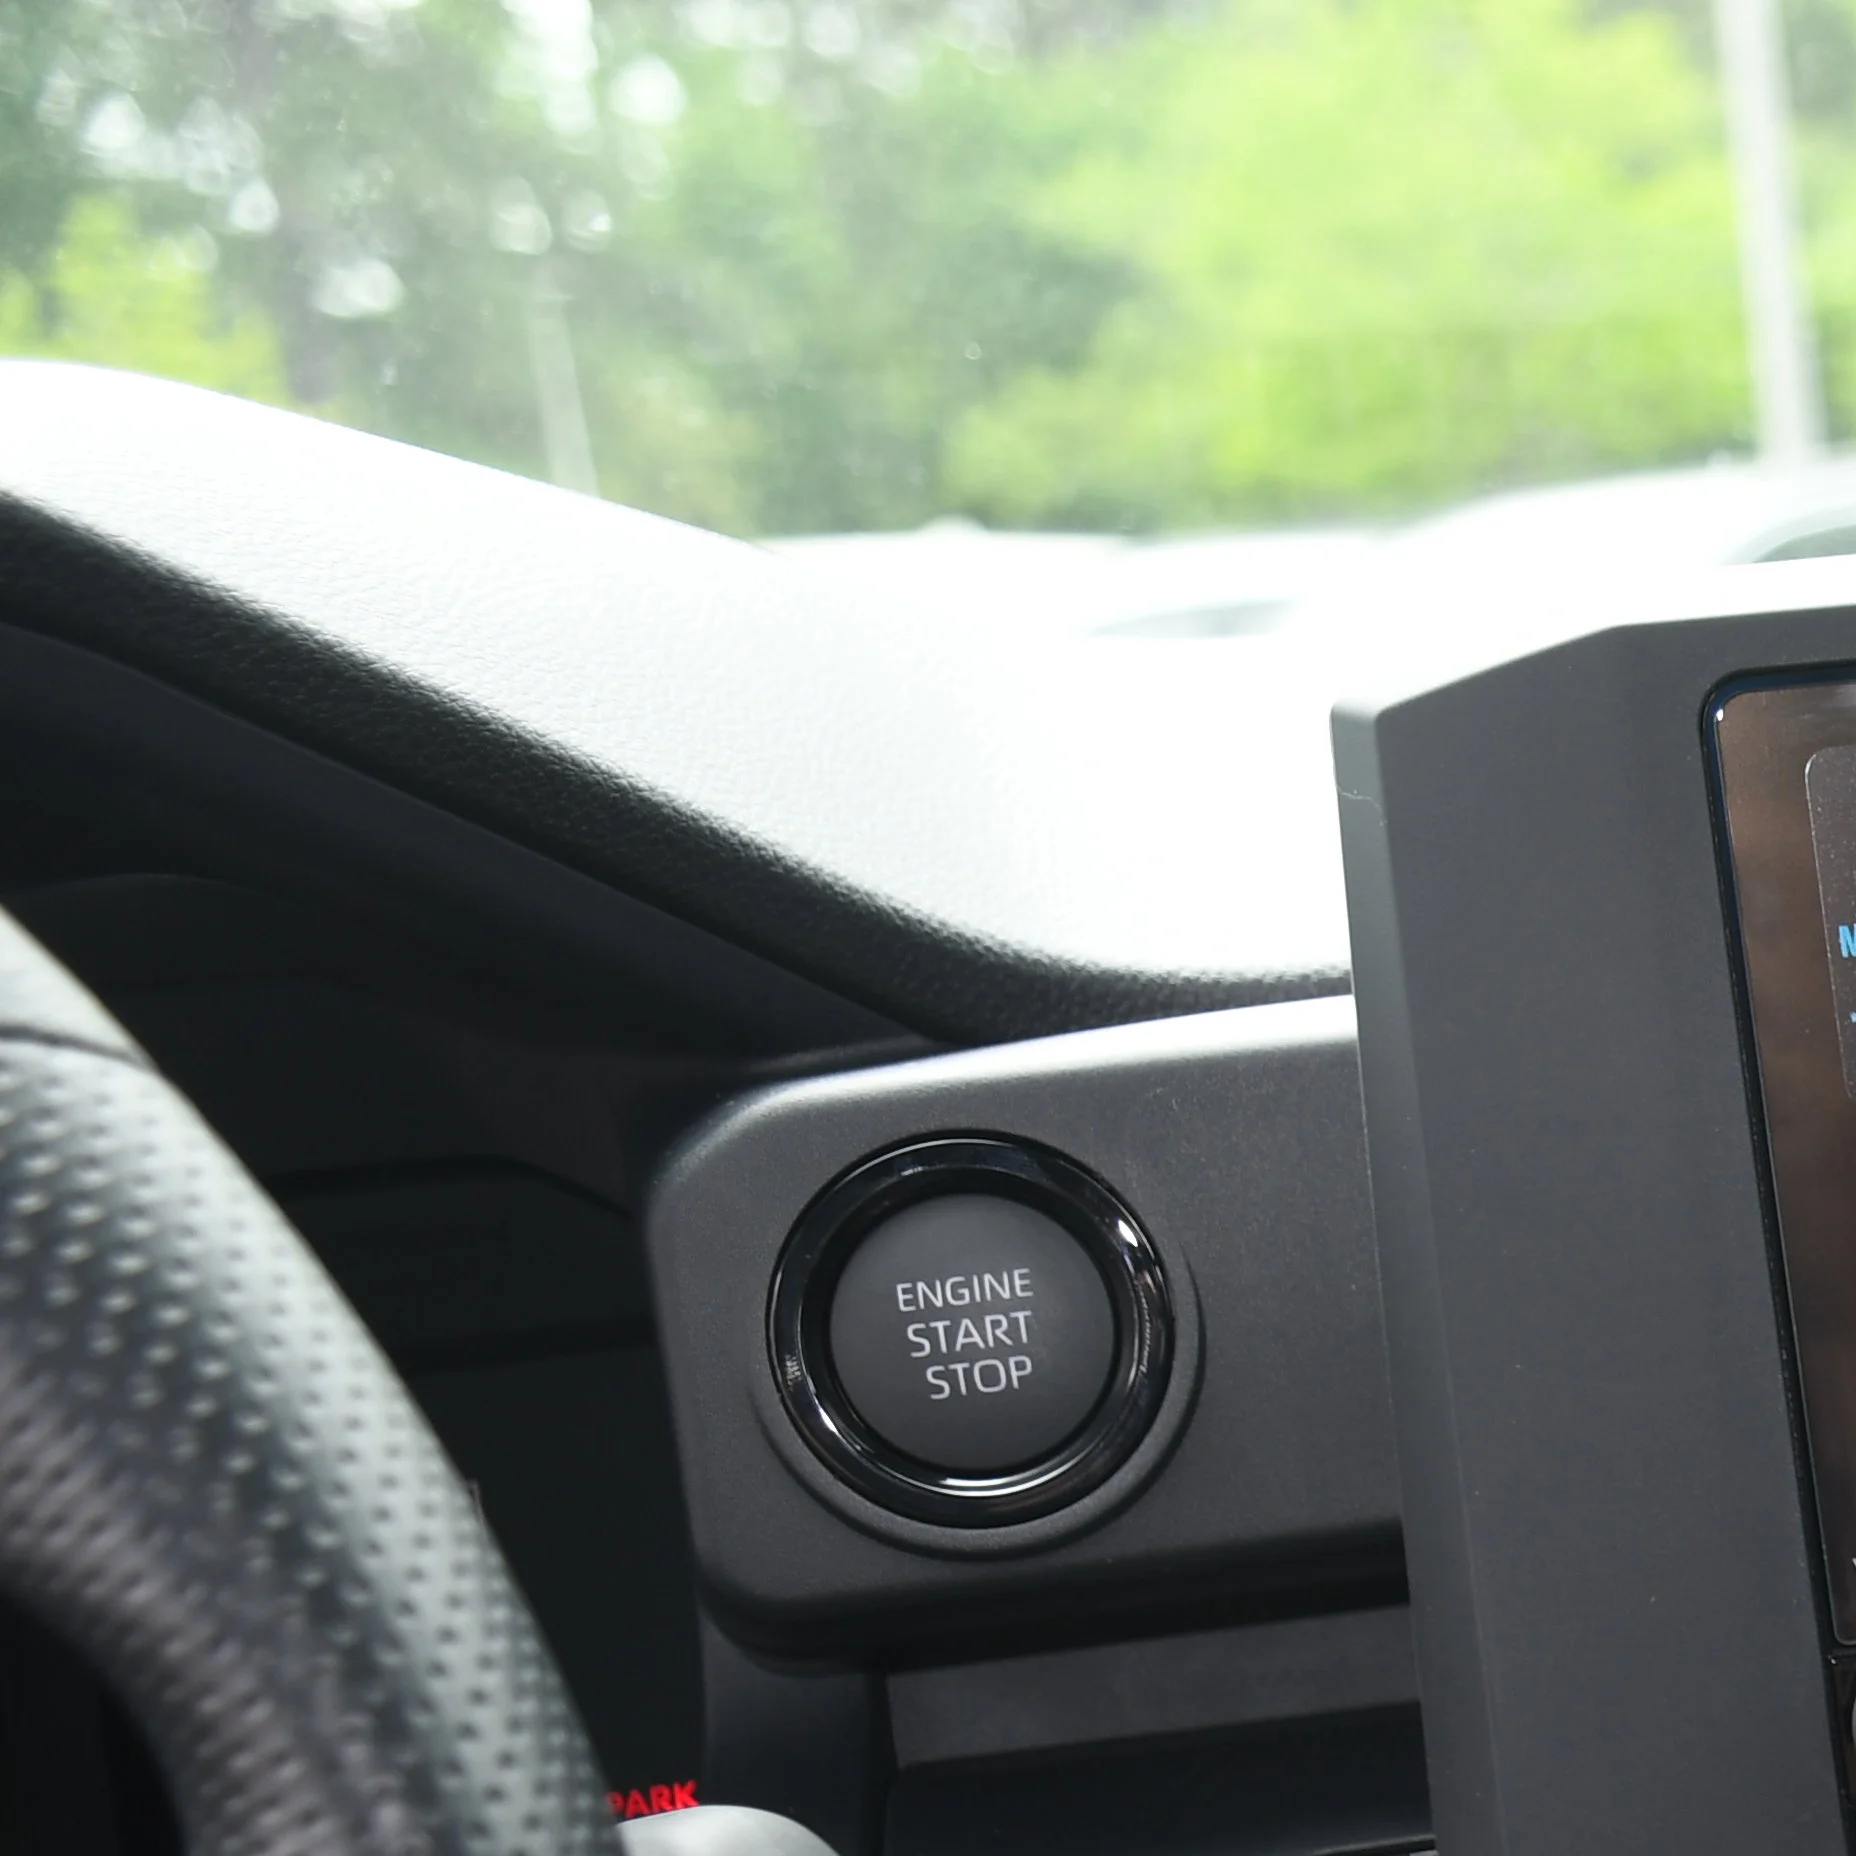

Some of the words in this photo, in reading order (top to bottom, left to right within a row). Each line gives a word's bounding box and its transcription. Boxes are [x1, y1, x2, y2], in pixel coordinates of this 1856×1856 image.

[896, 1268, 1034, 1313] ENGINE
[906, 1309, 1033, 1359] START
[925, 1355, 1033, 1400] STOP
